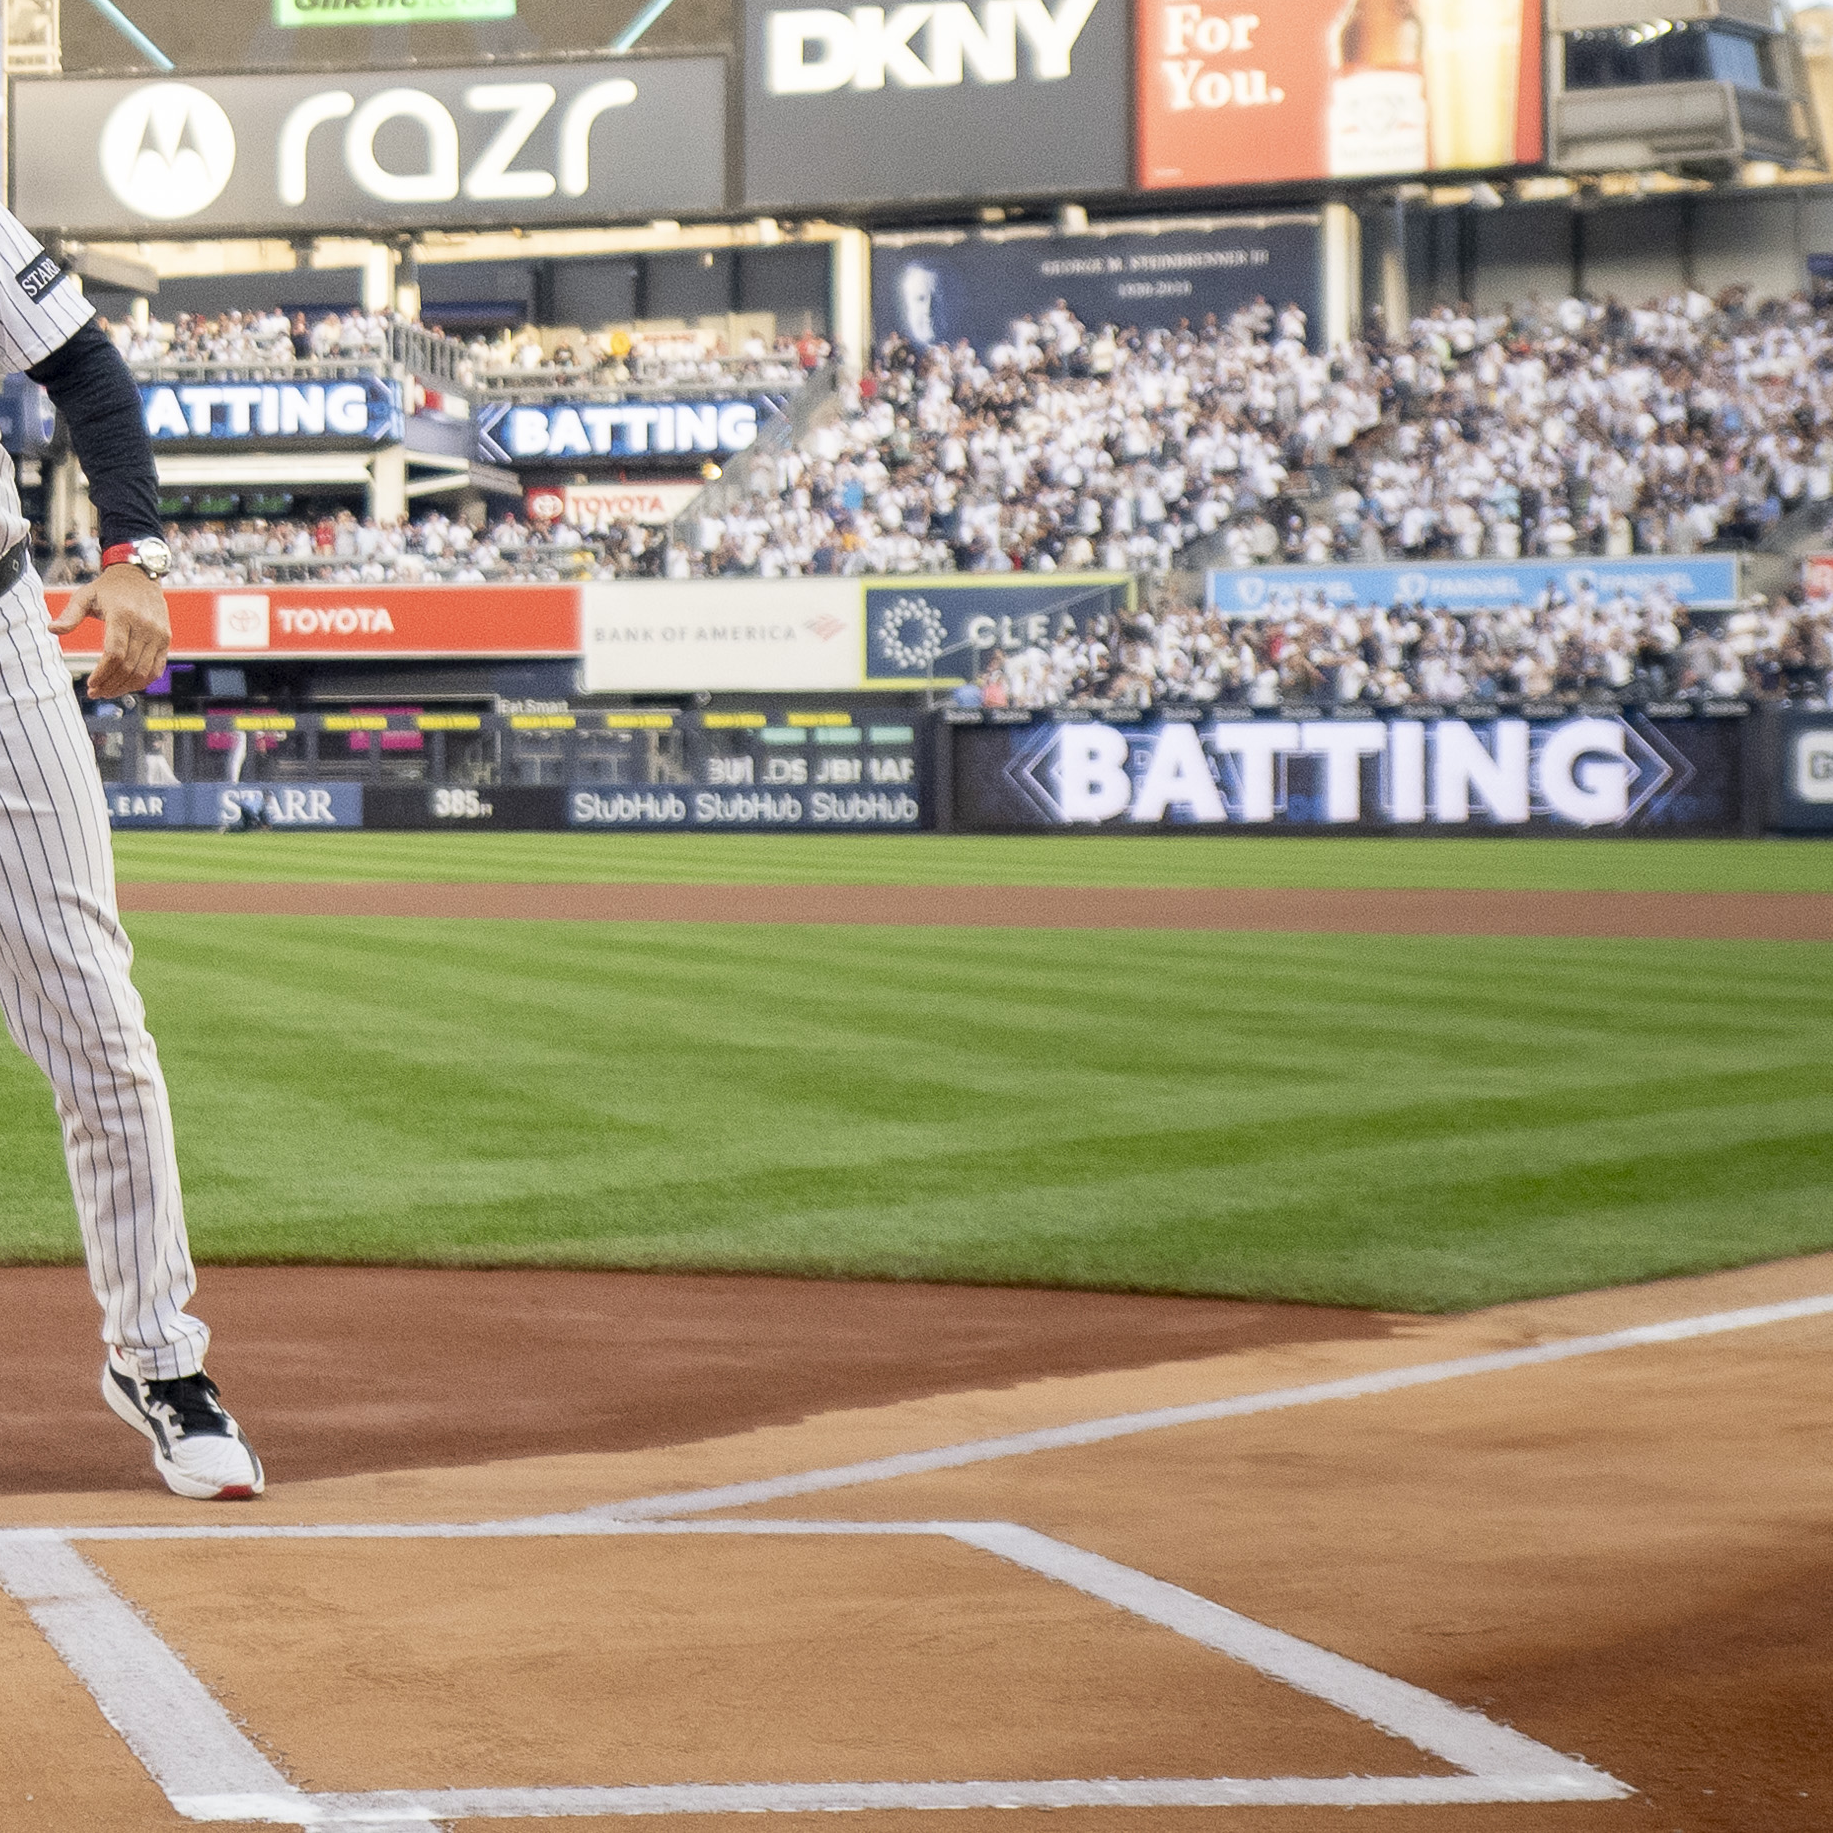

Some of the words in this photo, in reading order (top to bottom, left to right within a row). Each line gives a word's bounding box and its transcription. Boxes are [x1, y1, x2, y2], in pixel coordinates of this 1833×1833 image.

[1164, 7, 1258, 56] For
[1162, 59, 1286, 111] You.
[278, 78, 639, 207] razr
[21, 257, 62, 298] STARR
[145, 383, 369, 438] ATTING
[509, 403, 759, 456] BATTING
[572, 494, 666, 514] TOYOTA
[278, 606, 395, 635] TOYOTA
[594, 626, 655, 643] BANK
[661, 626, 688, 643] OF
[694, 624, 798, 643] AMERICA
[1059, 718, 1630, 826] BATTING
[573, 791, 687, 824] StubHub
[695, 791, 803, 824] StubHub
[811, 790, 919, 824] StubHub
